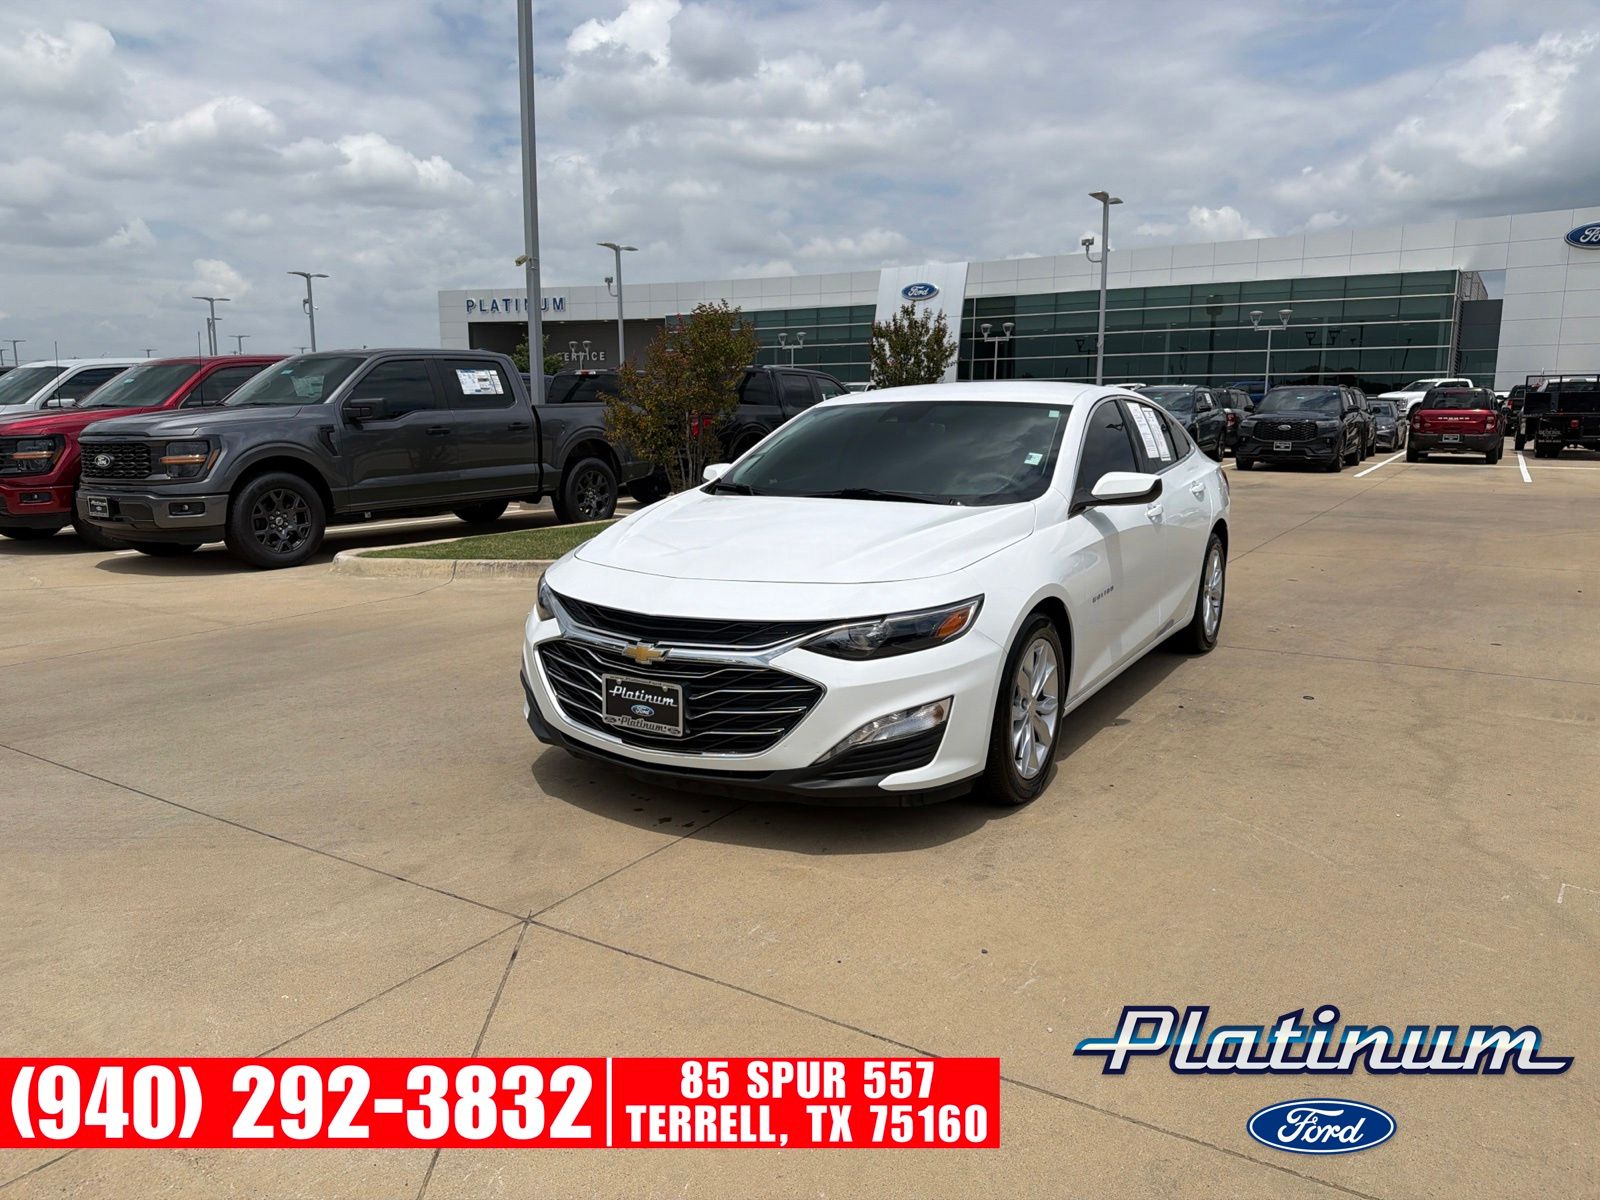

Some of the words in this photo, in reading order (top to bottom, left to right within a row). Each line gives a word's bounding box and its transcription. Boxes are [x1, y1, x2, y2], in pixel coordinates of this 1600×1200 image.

[466, 298, 566, 313] PLATIUM
[562, 351, 606, 361] ERVICE
[609, 685, 678, 707] Platinum
[621, 717, 664, 732] Platinum
